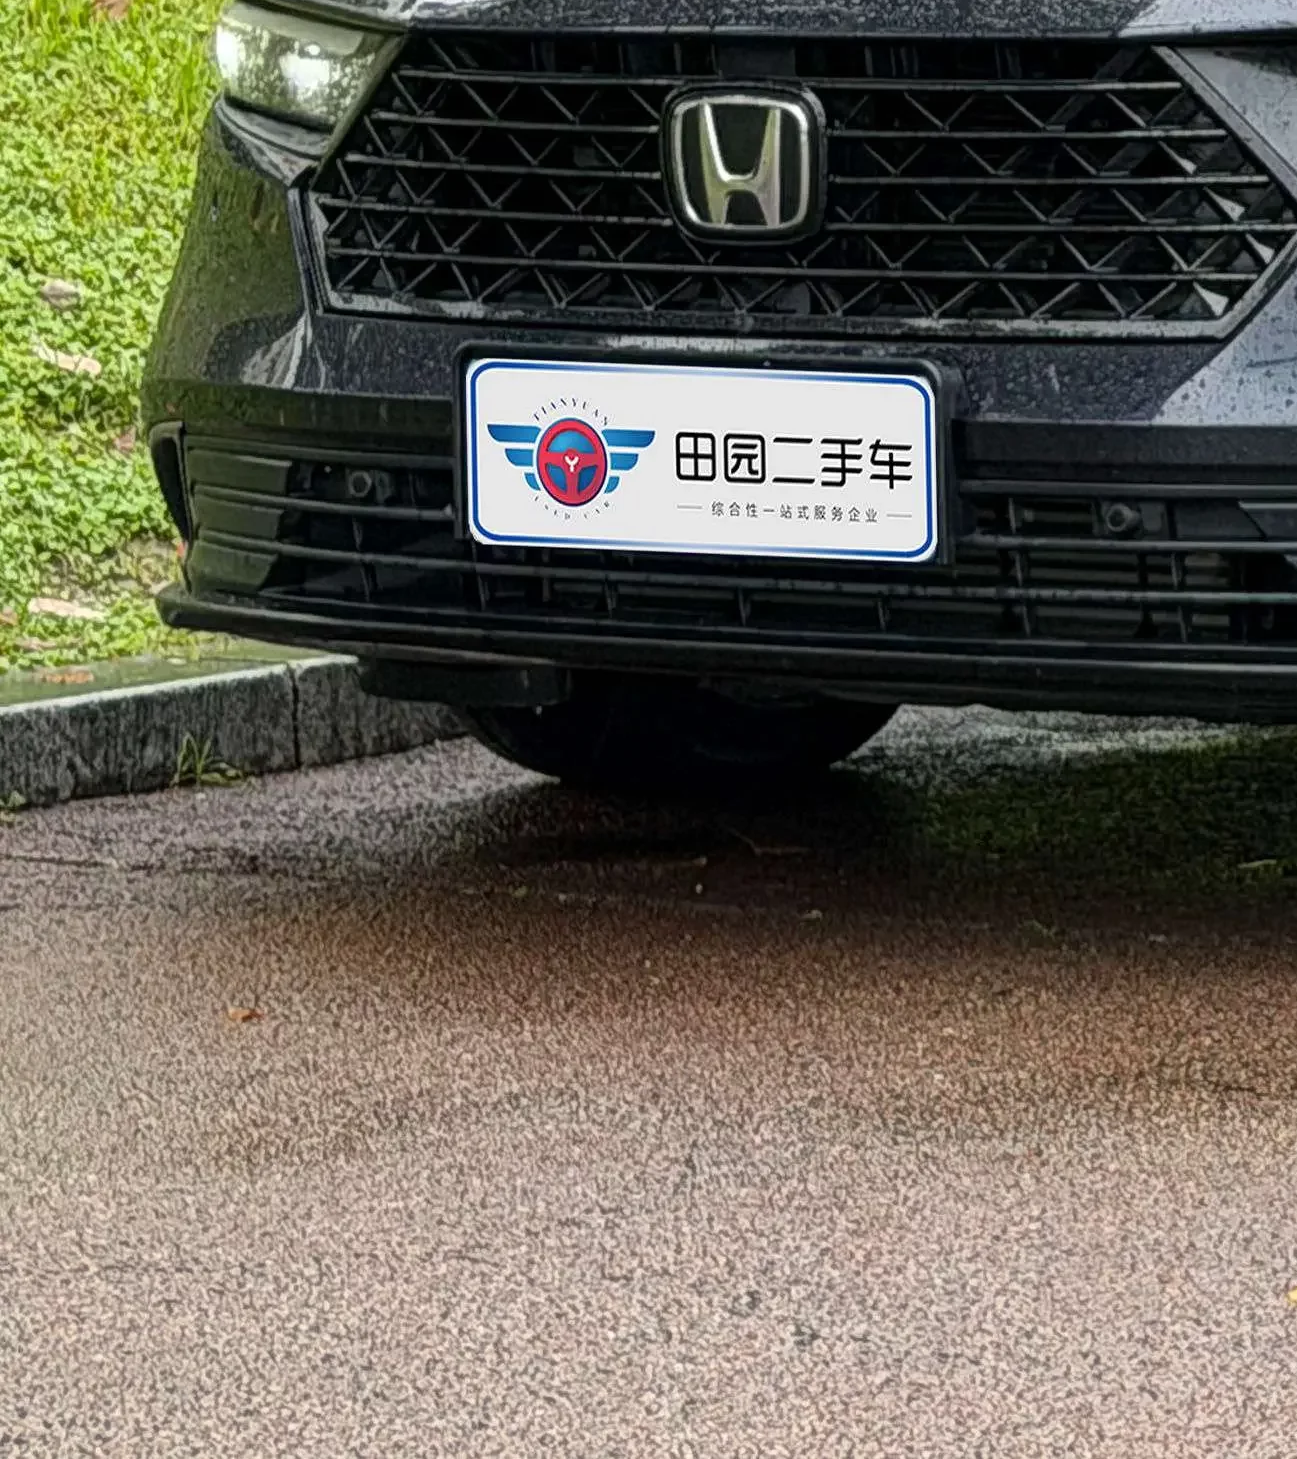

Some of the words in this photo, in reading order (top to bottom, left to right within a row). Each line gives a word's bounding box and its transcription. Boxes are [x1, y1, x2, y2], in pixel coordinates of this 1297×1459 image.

[675, 431, 913, 490] 田园二手车
[711, 500, 878, 523] 综合性一站式服务企业
